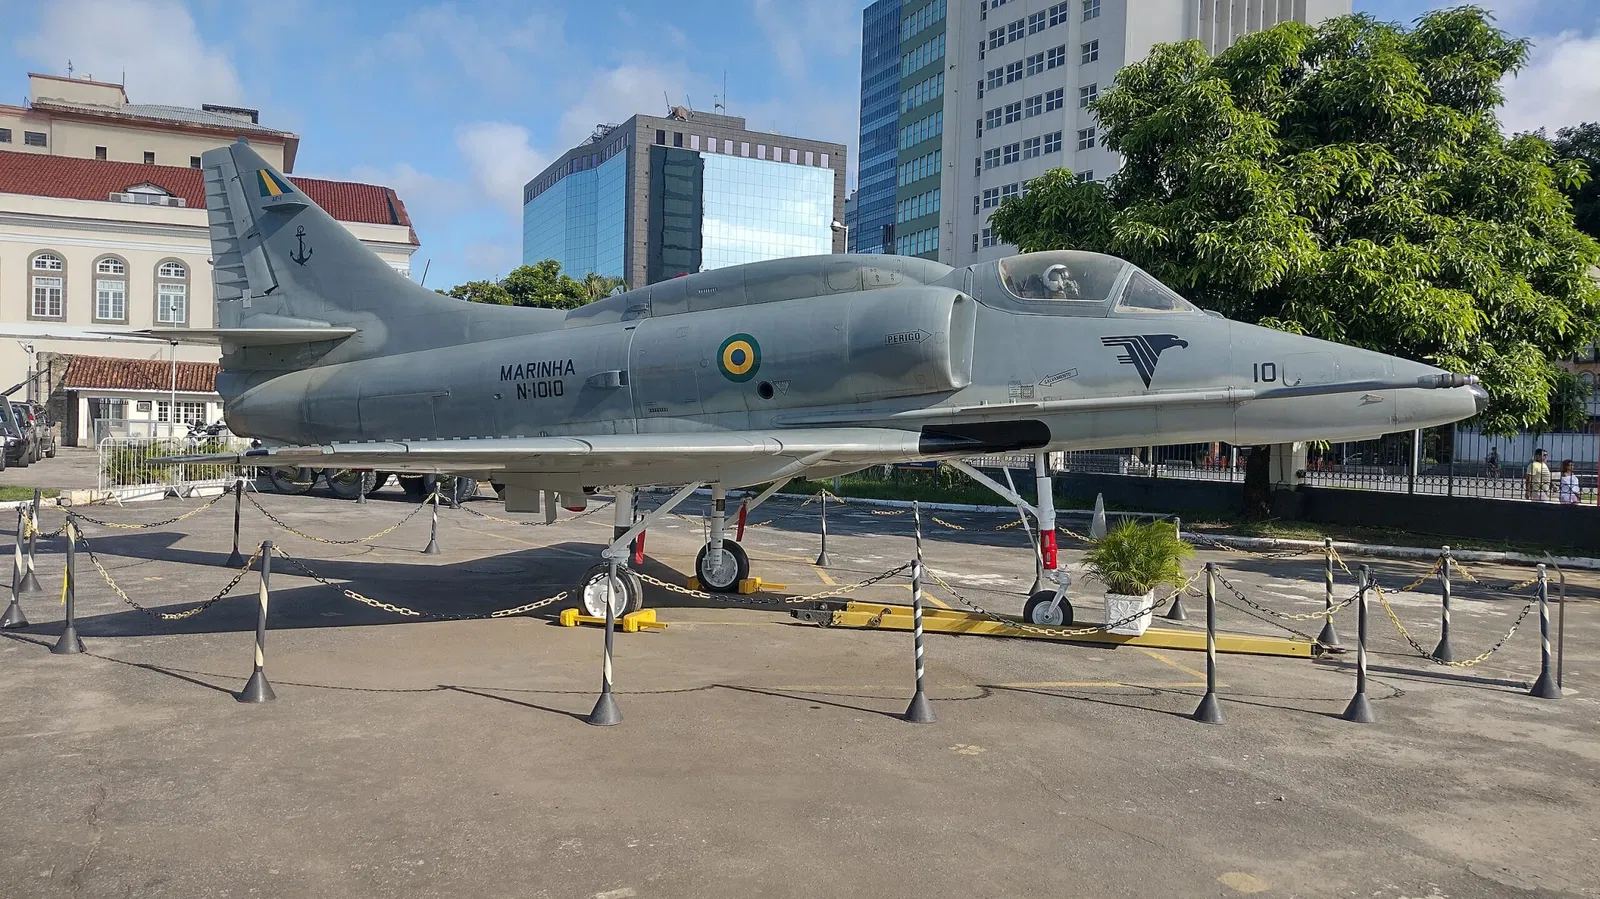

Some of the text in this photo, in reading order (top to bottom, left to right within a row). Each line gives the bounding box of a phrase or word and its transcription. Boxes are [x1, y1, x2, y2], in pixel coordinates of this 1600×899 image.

[887, 332, 921, 344] PERIGO
[500, 359, 576, 381] MARINHA
[1253, 362, 1277, 383] 10
[516, 380, 564, 400] N-1010
